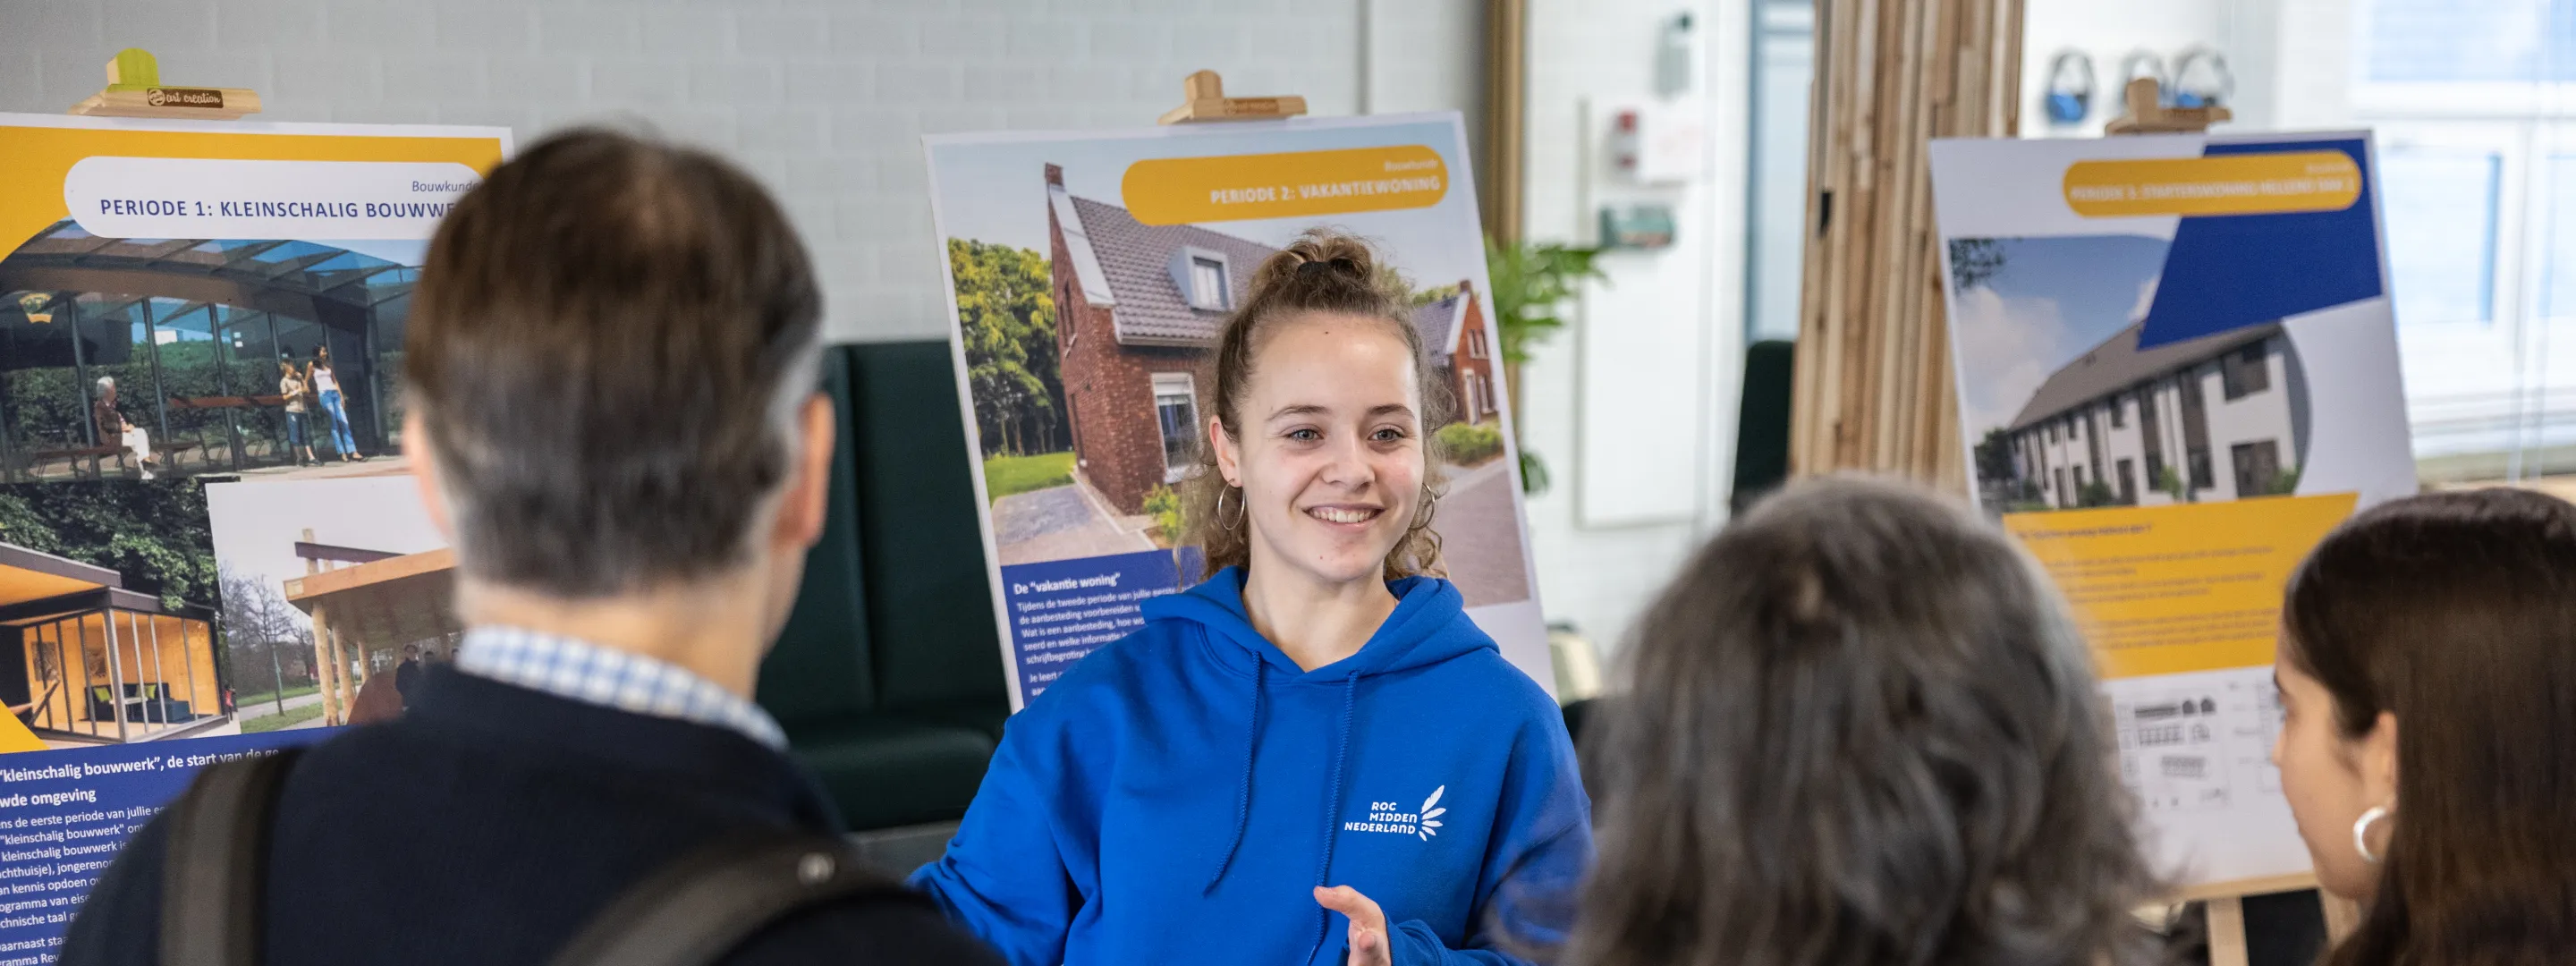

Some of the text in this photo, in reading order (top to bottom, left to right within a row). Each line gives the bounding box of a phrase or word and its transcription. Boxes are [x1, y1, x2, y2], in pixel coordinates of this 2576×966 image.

[166, 91, 182, 103] art
[183, 93, 221, 104] creation
[1210, 175, 1441, 205] PERIODE 2: VAKANTIEWONING
[100, 199, 456, 218] PERIODE 1: KLEINSCHALIG BOUWWE
[1013, 583, 1029, 596] De
[1016, 600, 1046, 614] Tijdens
[1046, 598, 1056, 610] de
[1057, 596, 1088, 608] tweede
[1088, 593, 1117, 606] periode
[1118, 592, 1132, 601] van
[1132, 588, 1152, 601] jullie
[1019, 614, 1031, 626] de
[1031, 608, 1083, 624] aanbesteding
[1083, 605, 1134, 619] voorbereiden
[1021, 628, 1038, 639] Wat
[1039, 627, 1046, 636] is
[1046, 625, 1063, 635] een
[1116, 617, 1131, 627] hoe
[1023, 640, 1046, 652] seerd
[1046, 639, 1057, 648] en
[1058, 636, 1081, 648] welke
[1081, 631, 1122, 645] informatie
[1029, 673, 1038, 683] Je
[1038, 671, 1057, 682] leert
[167, 755, 184, 769] de
[187, 753, 217, 767] start
[220, 752, 243, 764] van
[246, 749, 262, 760] de
[0, 788, 97, 809] wde omgeving
[1371, 801, 1397, 811] ROC
[15, 818, 29, 828] de
[30, 814, 63, 826] eerste
[65, 809, 105, 826] periode
[106, 809, 125, 820] van
[127, 806, 152, 820] jullie
[1369, 812, 1418, 823] MIDDEN
[1344, 822, 1416, 835] NEDERLAND
[2, 844, 62, 862] kleinschalig
[64, 841, 118, 856] bouwwerk
[12, 882, 46, 894] kennis
[47, 877, 88, 892] opdoen
[49, 896, 69, 907] van
[71, 894, 91, 904] eise
[0, 914, 46, 929] chnische
[47, 911, 67, 923] taal
[0, 937, 46, 953] aarnaast
